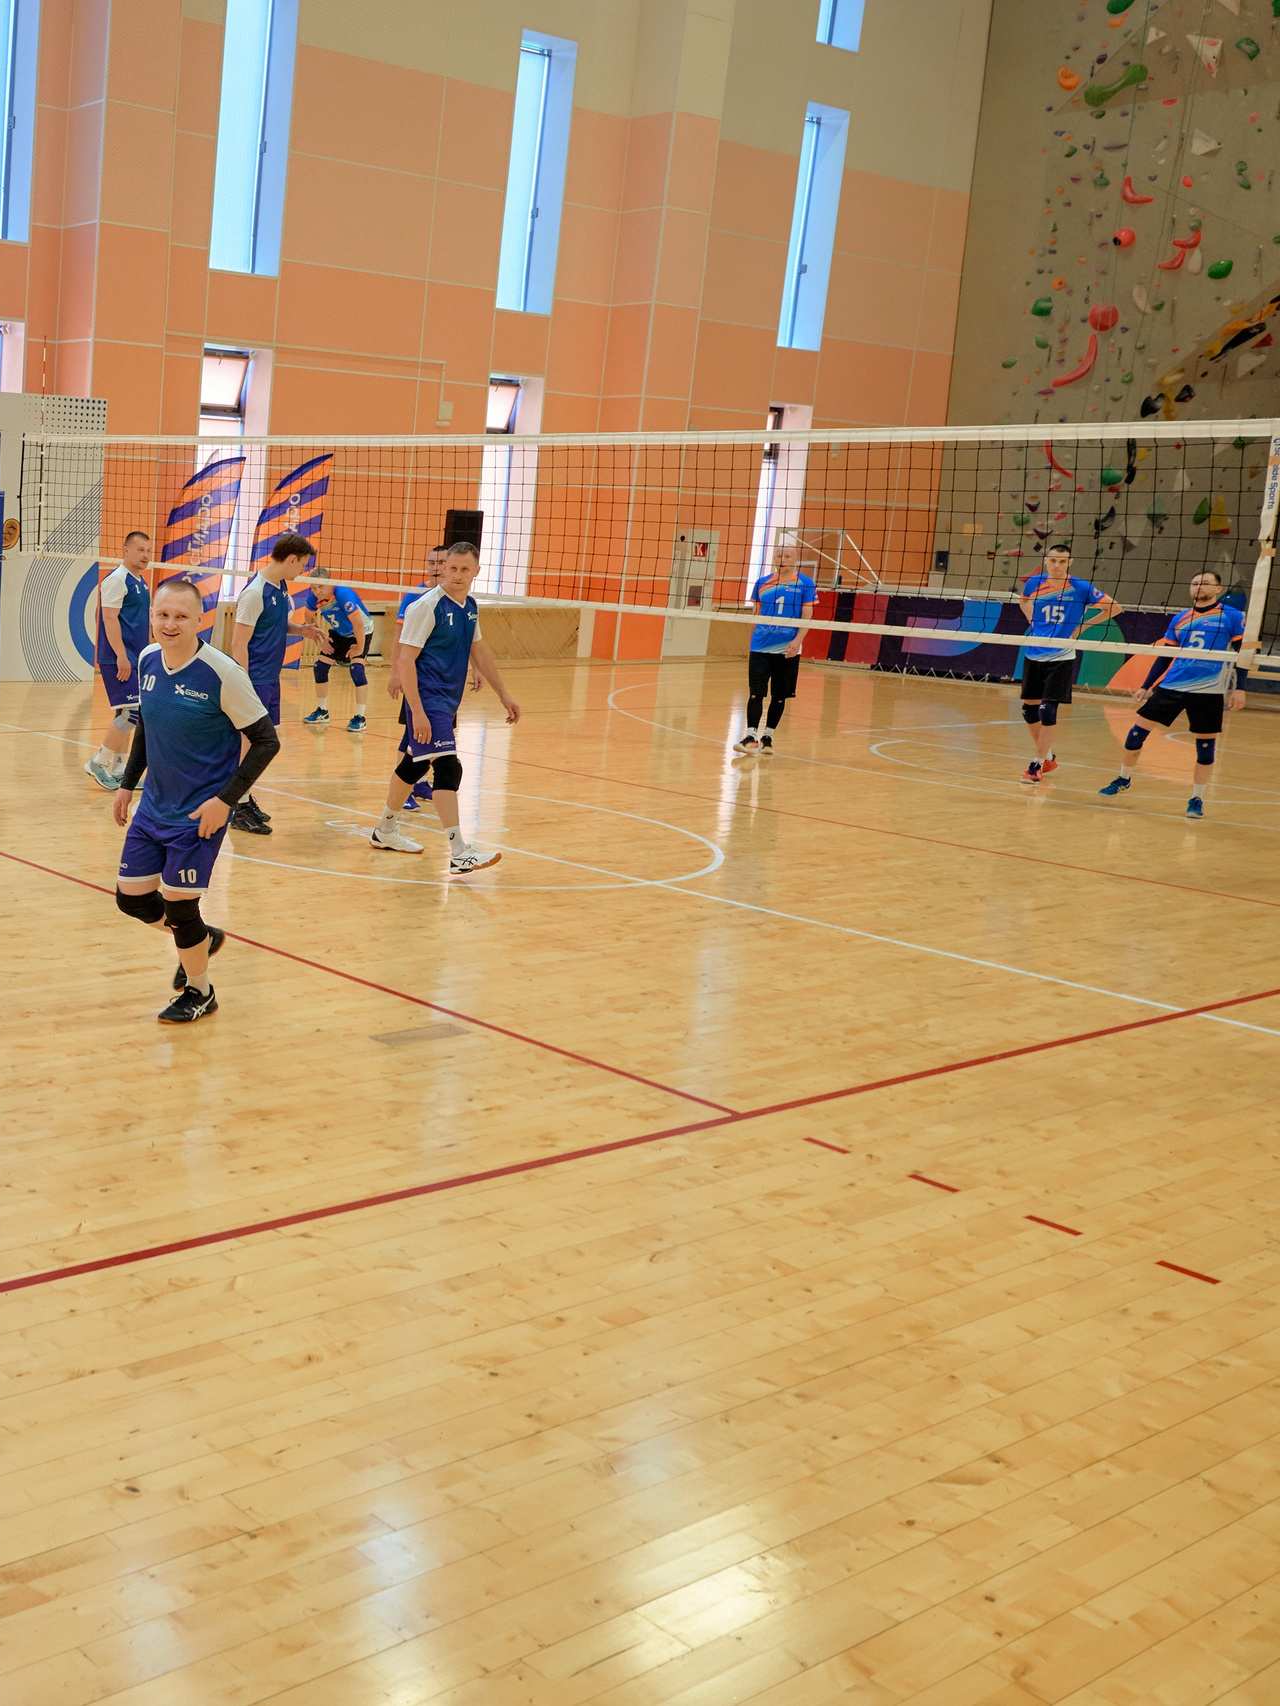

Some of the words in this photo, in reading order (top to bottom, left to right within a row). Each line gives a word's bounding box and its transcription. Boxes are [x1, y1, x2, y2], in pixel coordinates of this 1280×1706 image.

[775, 596, 785, 615] 1
[1041, 605, 1065, 624] 15
[327, 614, 339, 628] 3
[447, 612, 454, 625] 7
[1188, 630, 1206, 650] 5
[142, 674, 156, 692] 10
[178, 868, 197, 884] 10
